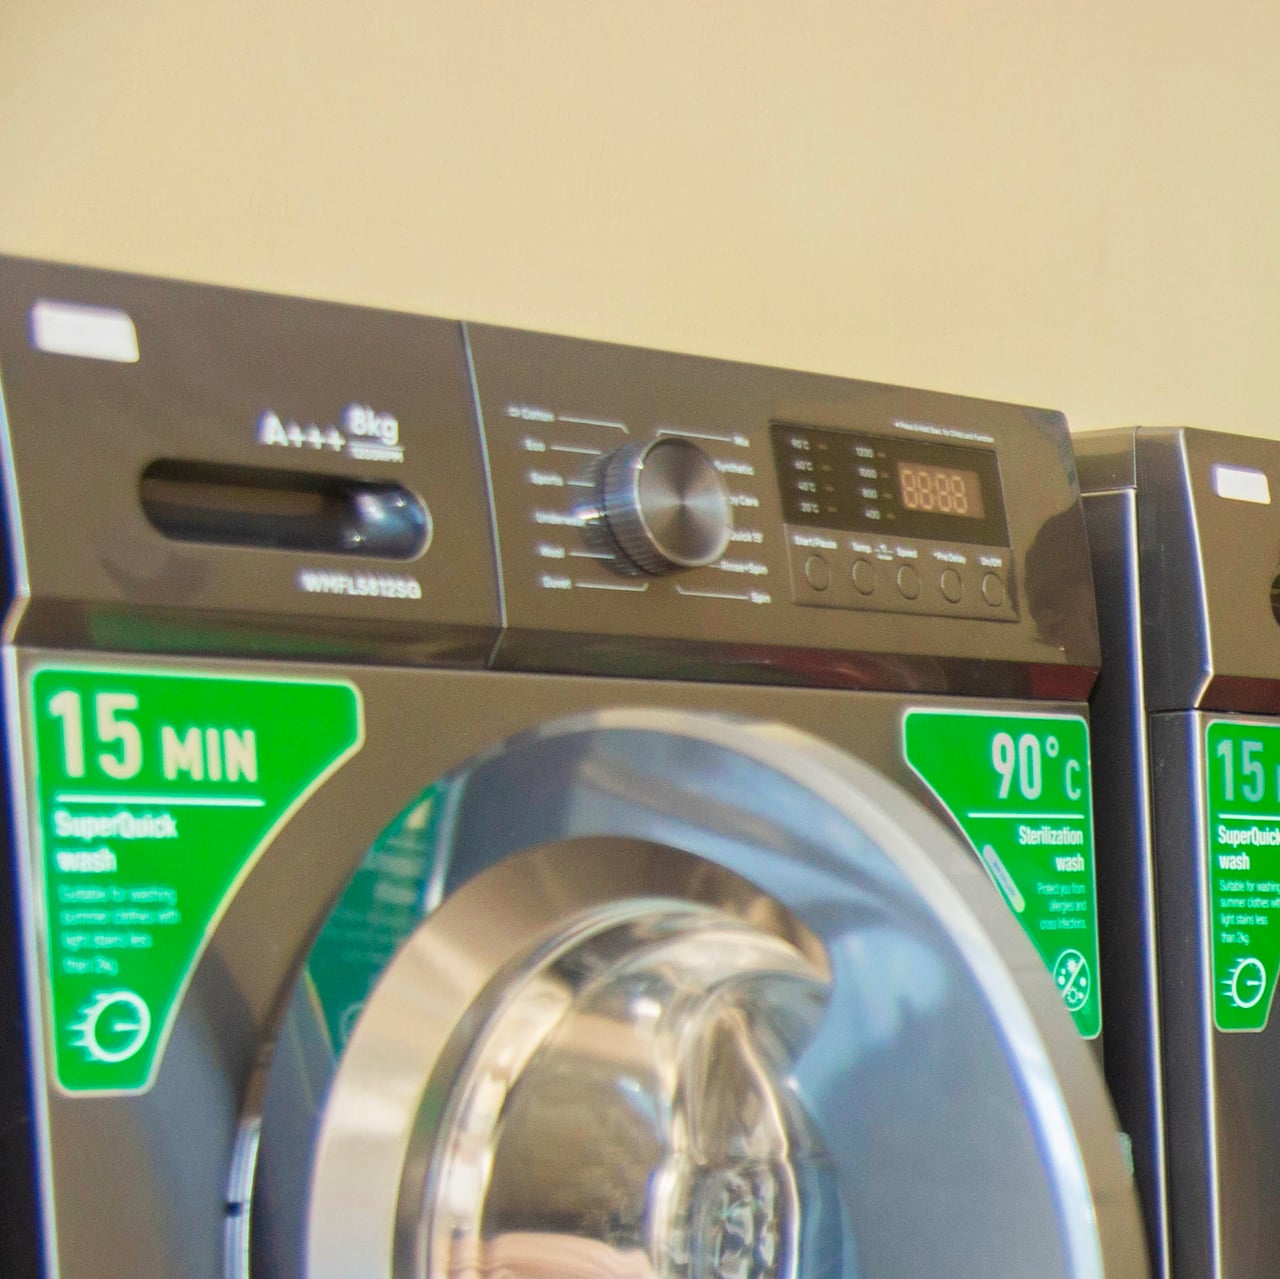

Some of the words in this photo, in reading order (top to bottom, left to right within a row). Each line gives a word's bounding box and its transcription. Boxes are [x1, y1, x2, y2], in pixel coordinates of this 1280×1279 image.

[260, 410, 345, 452] A+++
[348, 403, 400, 445] 8kg
[47, 689, 143, 780] 15
[160, 725, 259, 783] MIN
[1216, 738, 1266, 804] 15
[53, 810, 179, 842] SuperQuick
[1018, 825, 1084, 846] Sterilization
[56, 847, 118, 873] wash
[1055, 855, 1085, 872] wash
[1219, 852, 1250, 871] wash
